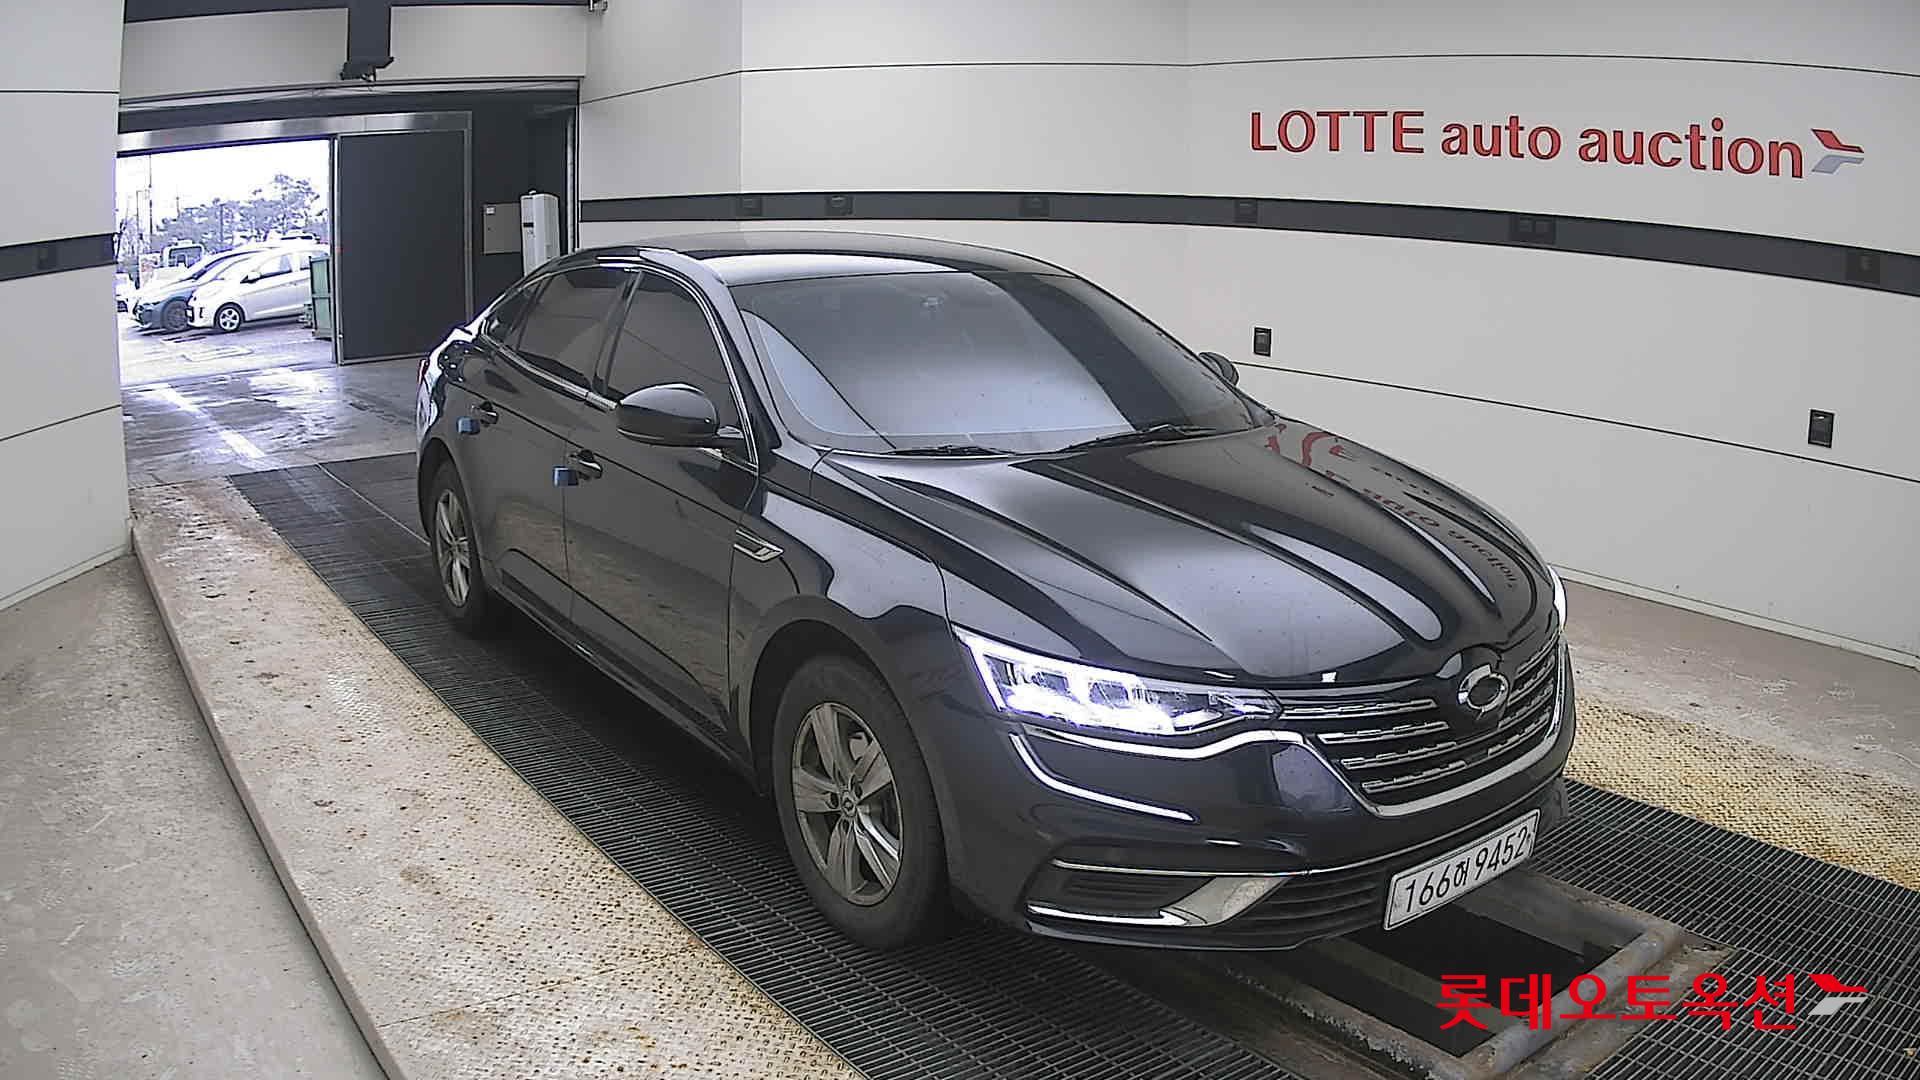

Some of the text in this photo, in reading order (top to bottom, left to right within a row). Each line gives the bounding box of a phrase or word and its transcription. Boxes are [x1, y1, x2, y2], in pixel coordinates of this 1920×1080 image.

[1250, 110, 1804, 179] LOTTE auto auction
[1475, 826, 1528, 881] 9452
